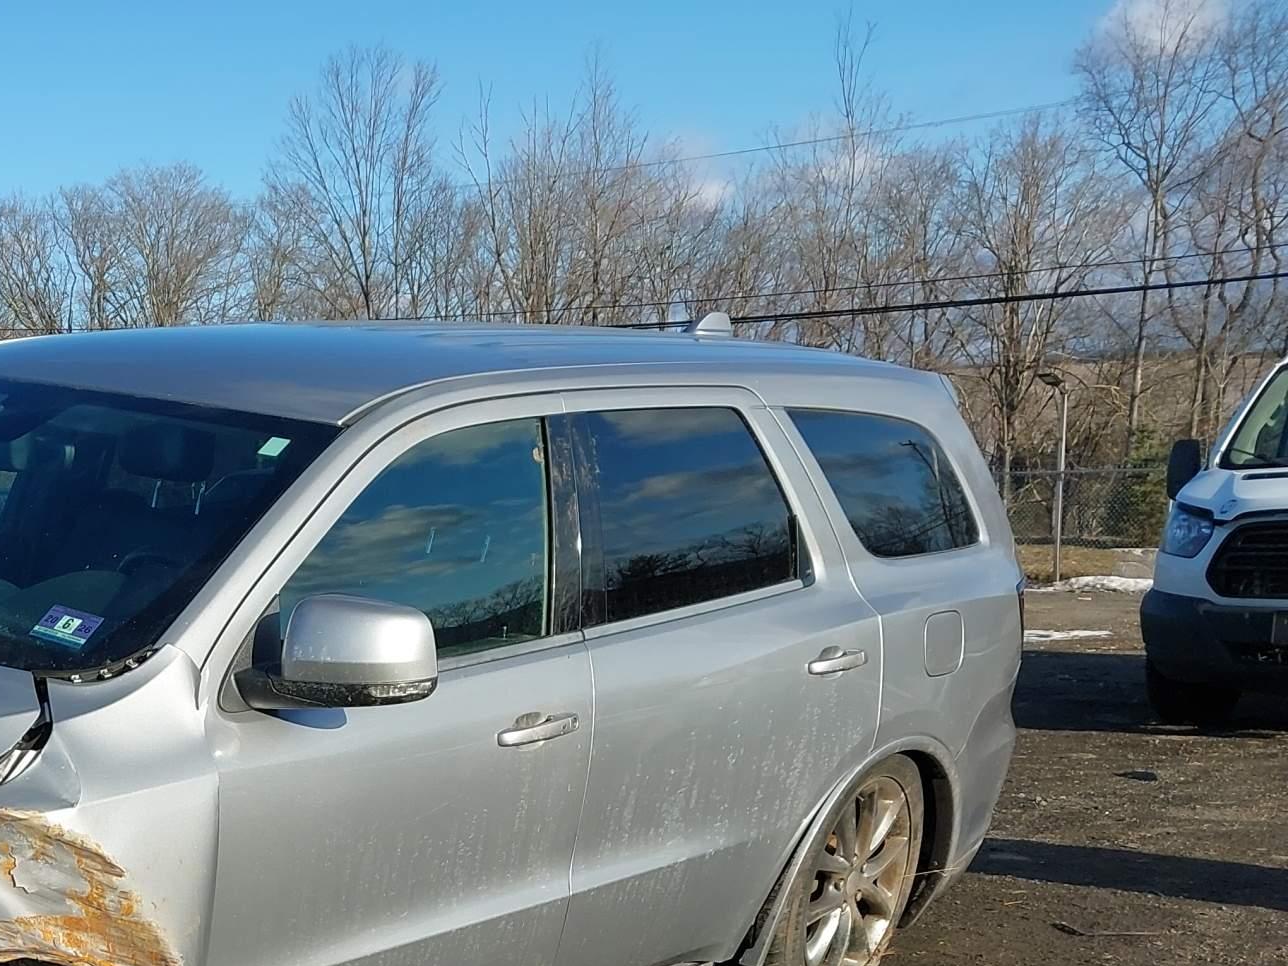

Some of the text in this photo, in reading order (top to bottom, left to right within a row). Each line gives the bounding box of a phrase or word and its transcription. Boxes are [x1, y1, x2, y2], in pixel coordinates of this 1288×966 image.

[44, 614, 93, 634] 20 6 26
